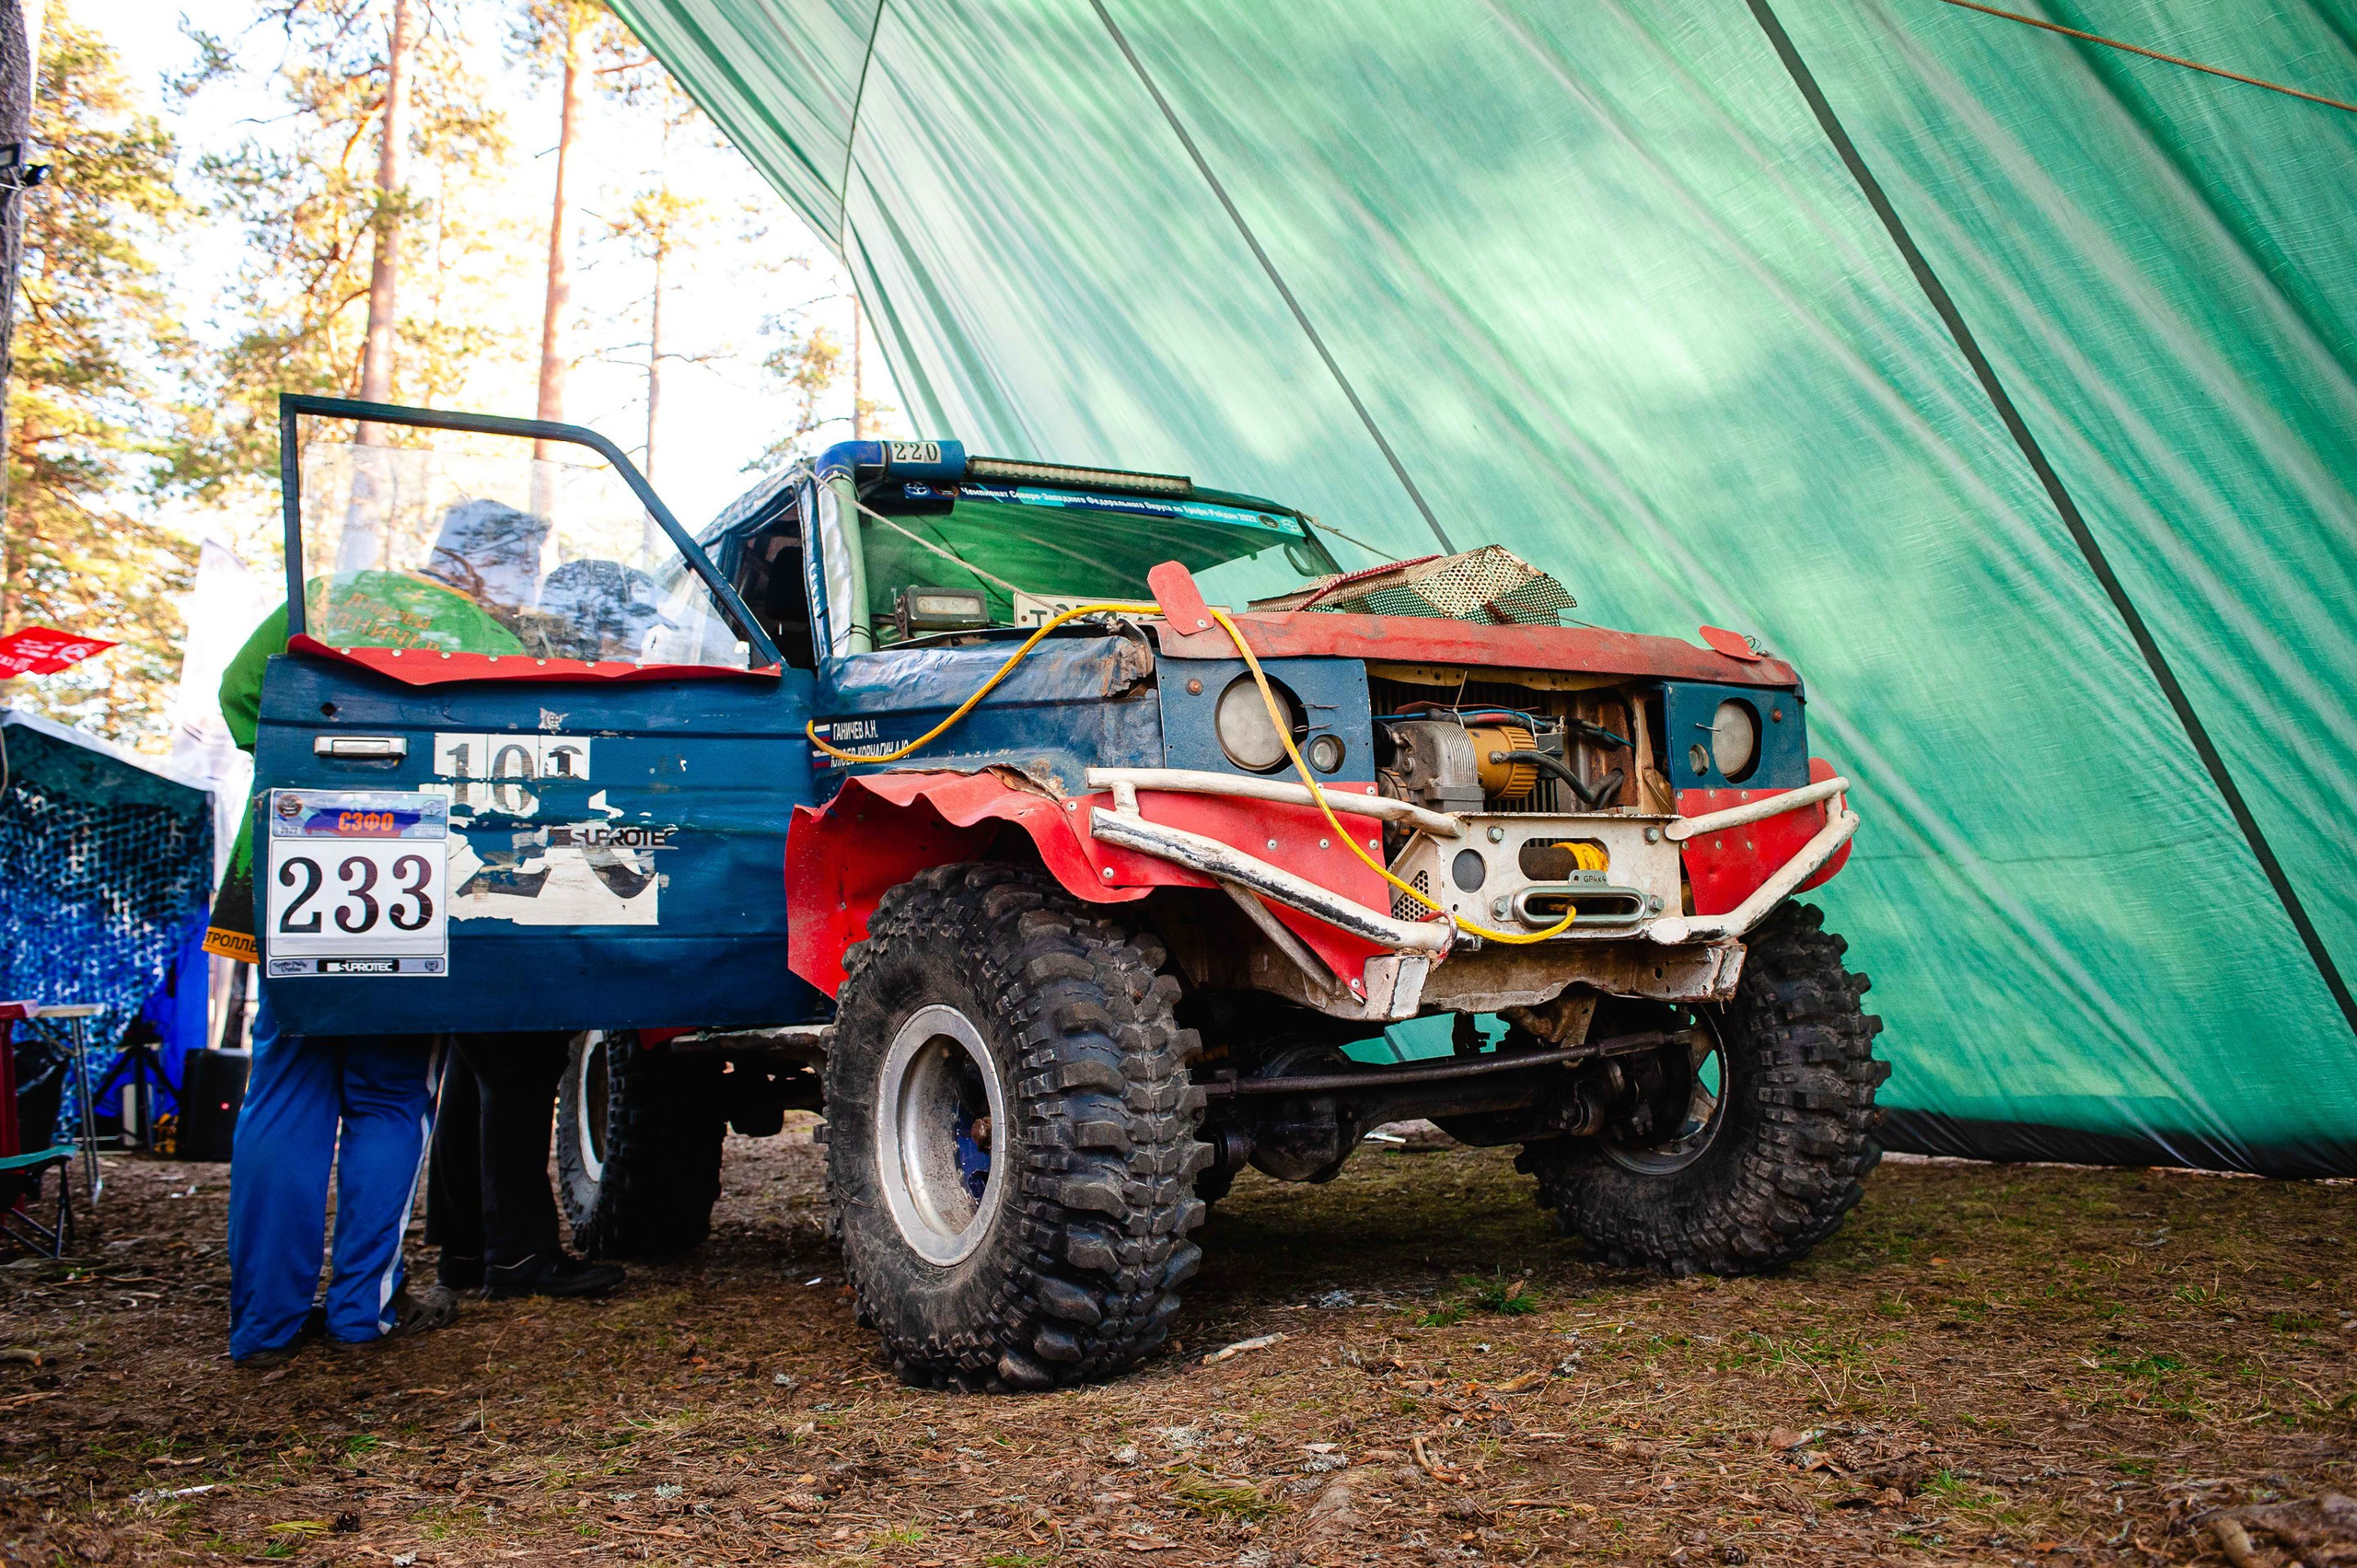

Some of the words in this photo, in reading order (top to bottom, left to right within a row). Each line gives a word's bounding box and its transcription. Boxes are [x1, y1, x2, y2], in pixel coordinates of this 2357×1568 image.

[894, 443, 939, 460] 220
[960, 487, 1009, 498] Чемпионат
[1009, 490, 1086, 505] Северо-Западного
[1086, 495, 1145, 509] Федерального
[1145, 501, 1172, 513] Округа
[1237, 512, 1259, 523] 2022
[833, 721, 864, 740] ГАНИЧЕВ
[865, 720, 878, 738] А.Н.
[338, 811, 395, 832] СЗФО
[279, 854, 433, 934] 233
[339, 961, 393, 973] SUPROTEC
